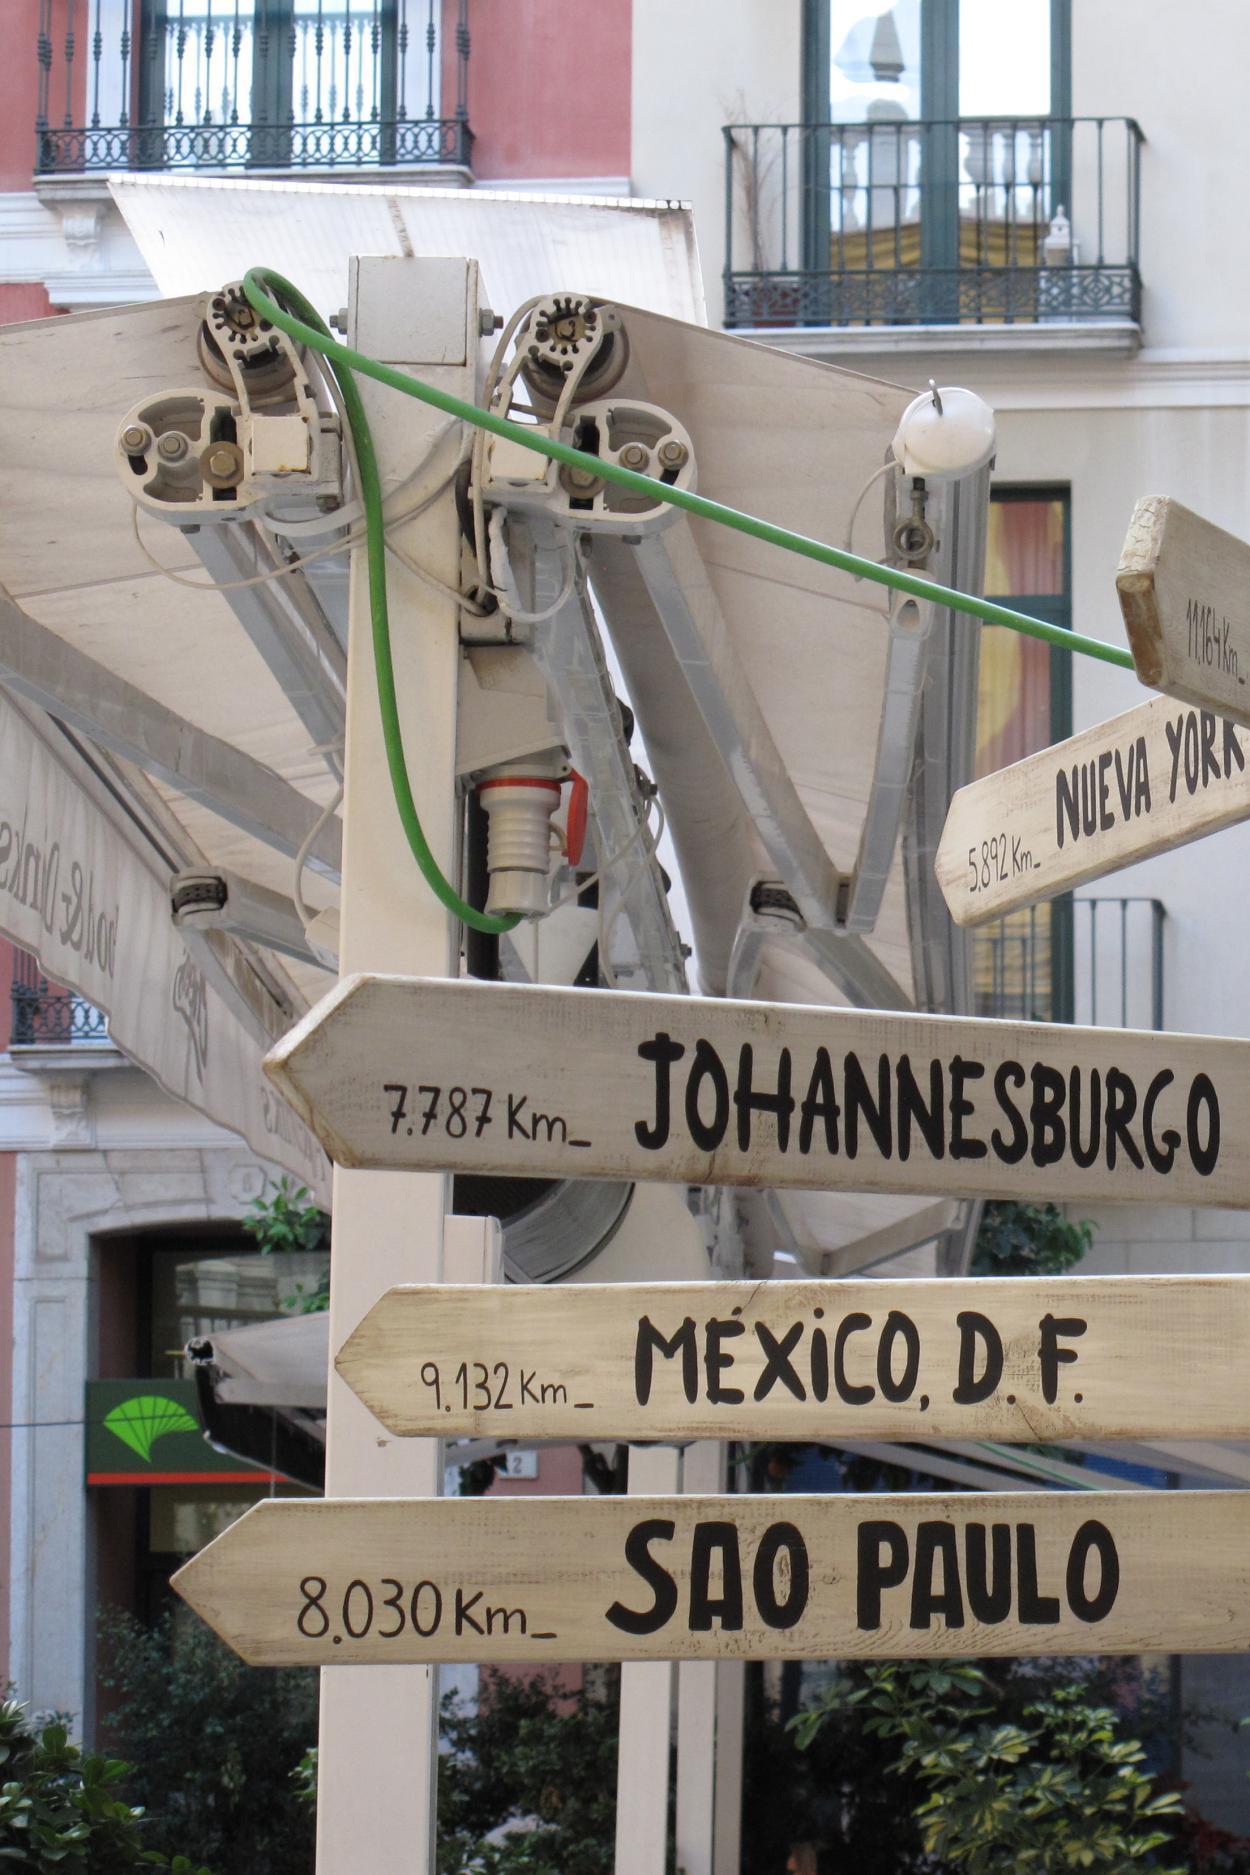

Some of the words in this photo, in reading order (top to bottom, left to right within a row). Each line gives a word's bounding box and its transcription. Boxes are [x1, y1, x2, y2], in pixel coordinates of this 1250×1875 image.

[1056, 736, 1152, 849] NUEVA
[1165, 709, 1246, 804] YORK
[382, 1083, 493, 1139] 7.787
[634, 1031, 1221, 1178] JOHANNESBURGO
[420, 1361, 514, 1413] 9.132
[296, 1575, 443, 1645] 8.030
[604, 1518, 810, 1636] SAO
[856, 1519, 1120, 1632] PAULO
